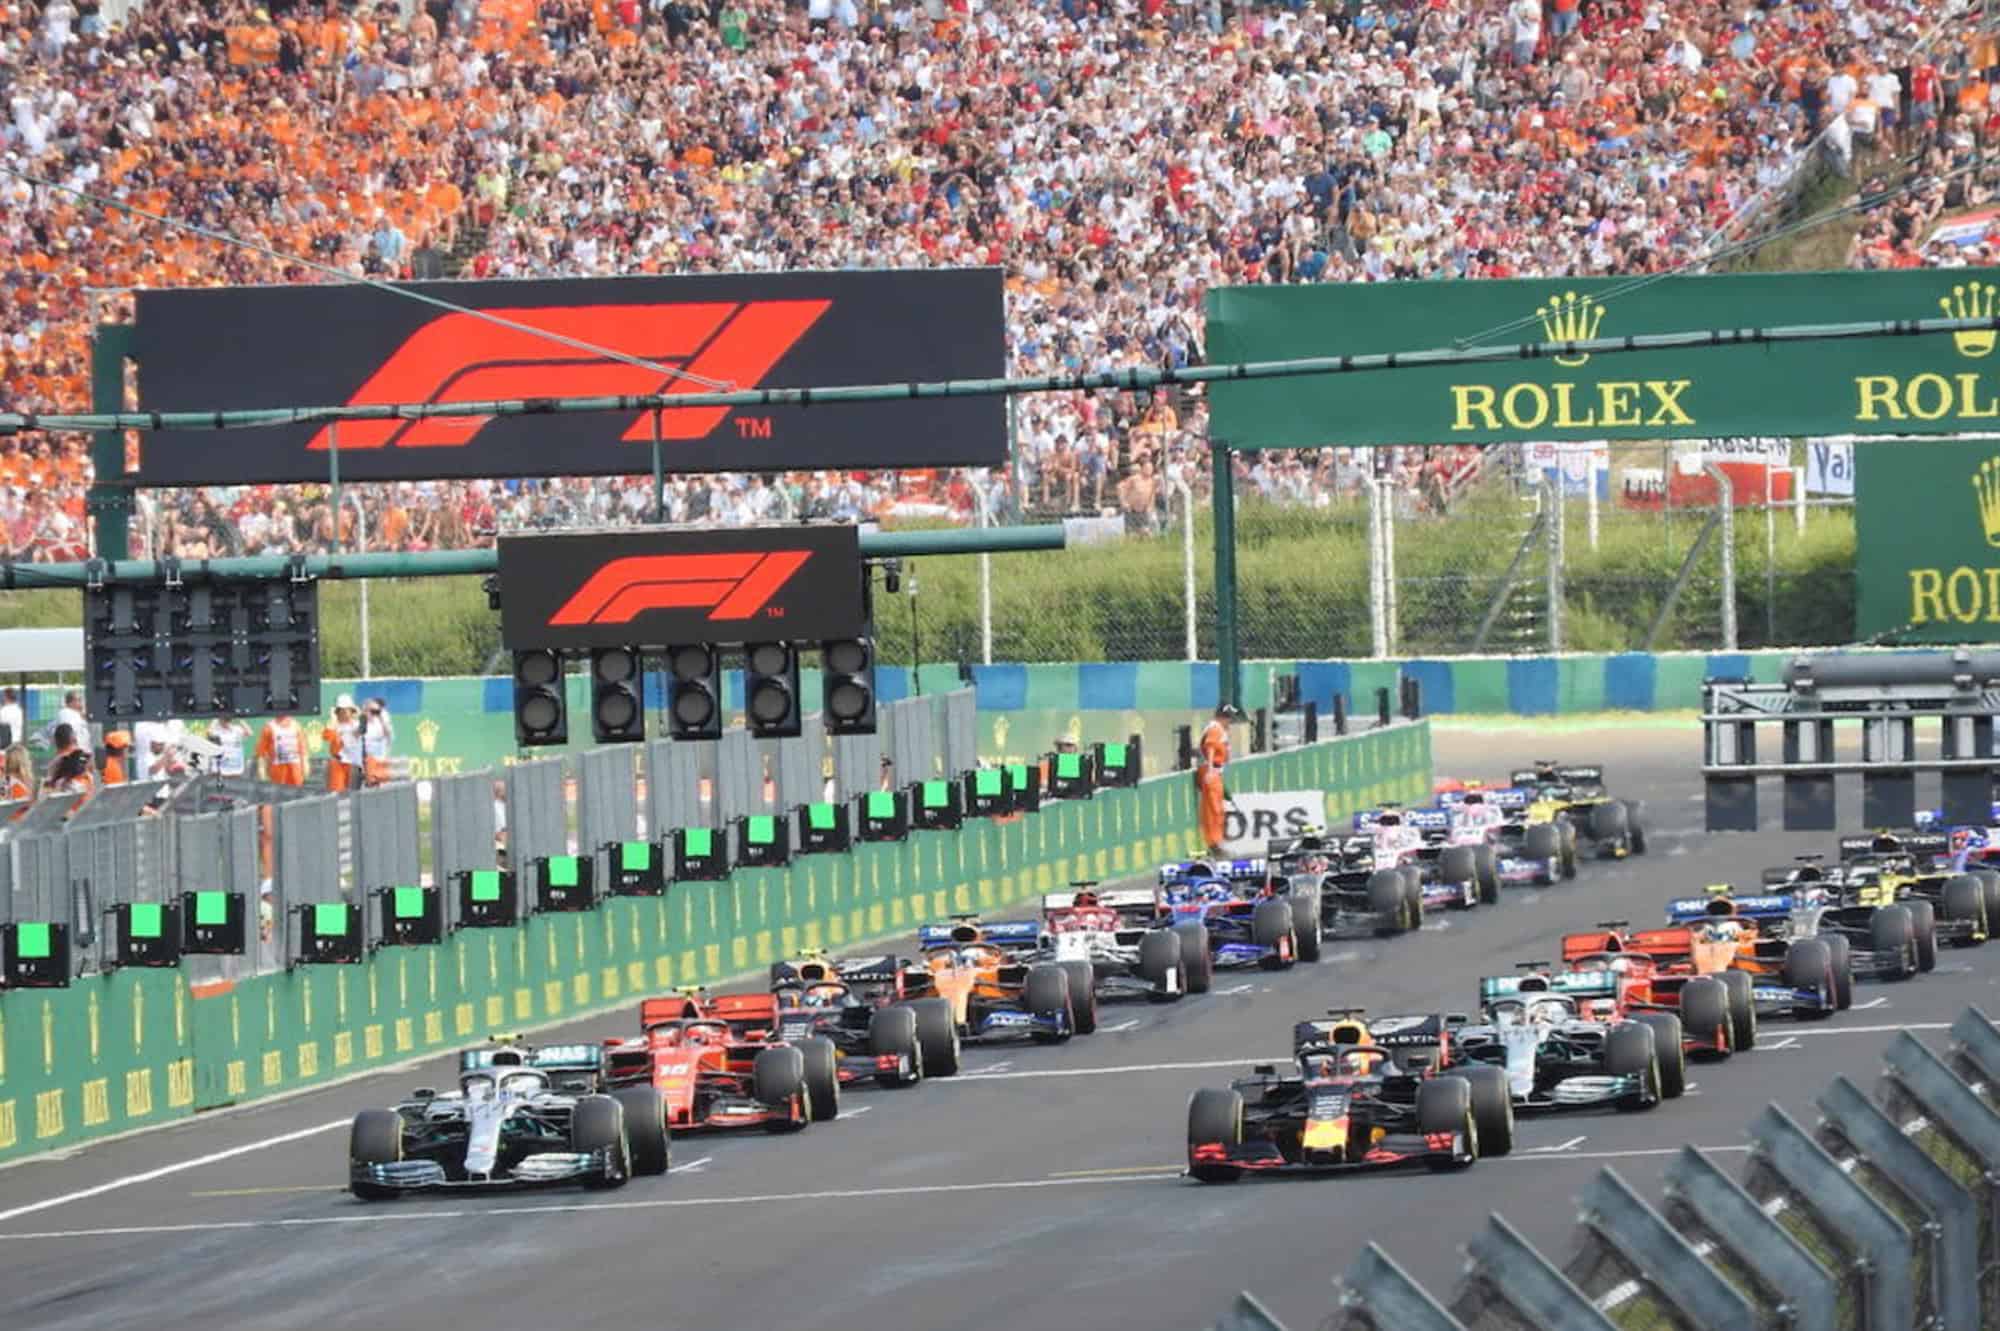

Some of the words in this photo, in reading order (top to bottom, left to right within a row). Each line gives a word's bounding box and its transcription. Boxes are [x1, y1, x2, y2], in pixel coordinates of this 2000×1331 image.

[1451, 380, 1695, 431] ROLEX
[1855, 372, 2000, 421] ROL
[735, 417, 773, 438] TM
[1222, 805, 1311, 841] DRS
